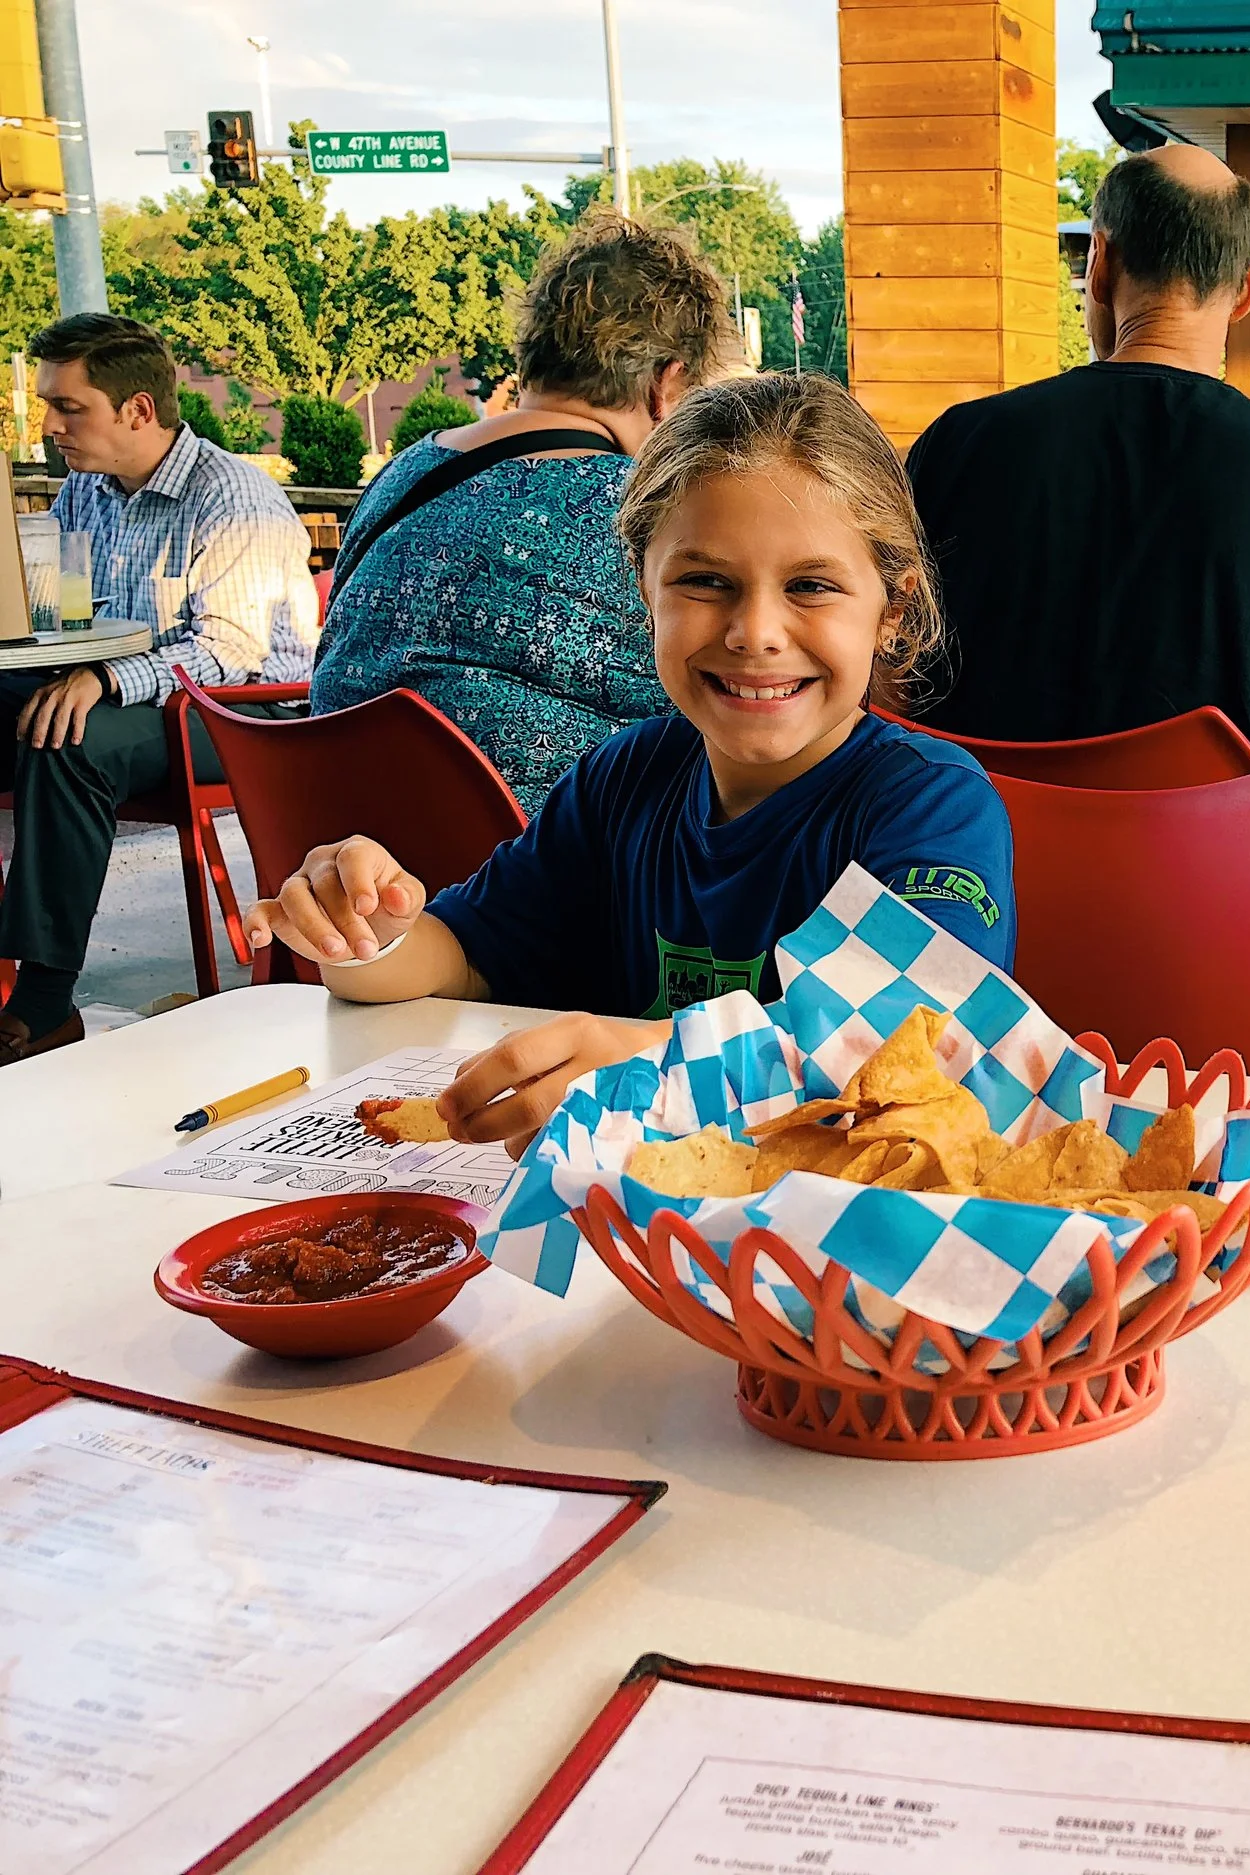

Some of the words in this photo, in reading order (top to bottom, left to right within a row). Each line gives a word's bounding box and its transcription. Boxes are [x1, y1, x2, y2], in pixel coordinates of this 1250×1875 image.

[329, 137, 341, 151] W
[348, 136, 382, 151] 47TH
[389, 135, 442, 151] AVENUE
[314, 154, 365, 169] COUNTY
[373, 154, 403, 169] LINE
[409, 153, 429, 169] RD
[290, 1115, 363, 1132] MENU
[238, 1134, 363, 1162] LITTLE
[268, 1125, 405, 1150] PORKERS
[74, 1429, 153, 1458] STREET
[149, 1448, 217, 1471] TACOS
[753, 1782, 790, 1796] SPICY
[797, 1786, 849, 1804] TEQUILA
[856, 1793, 888, 1807] LIME
